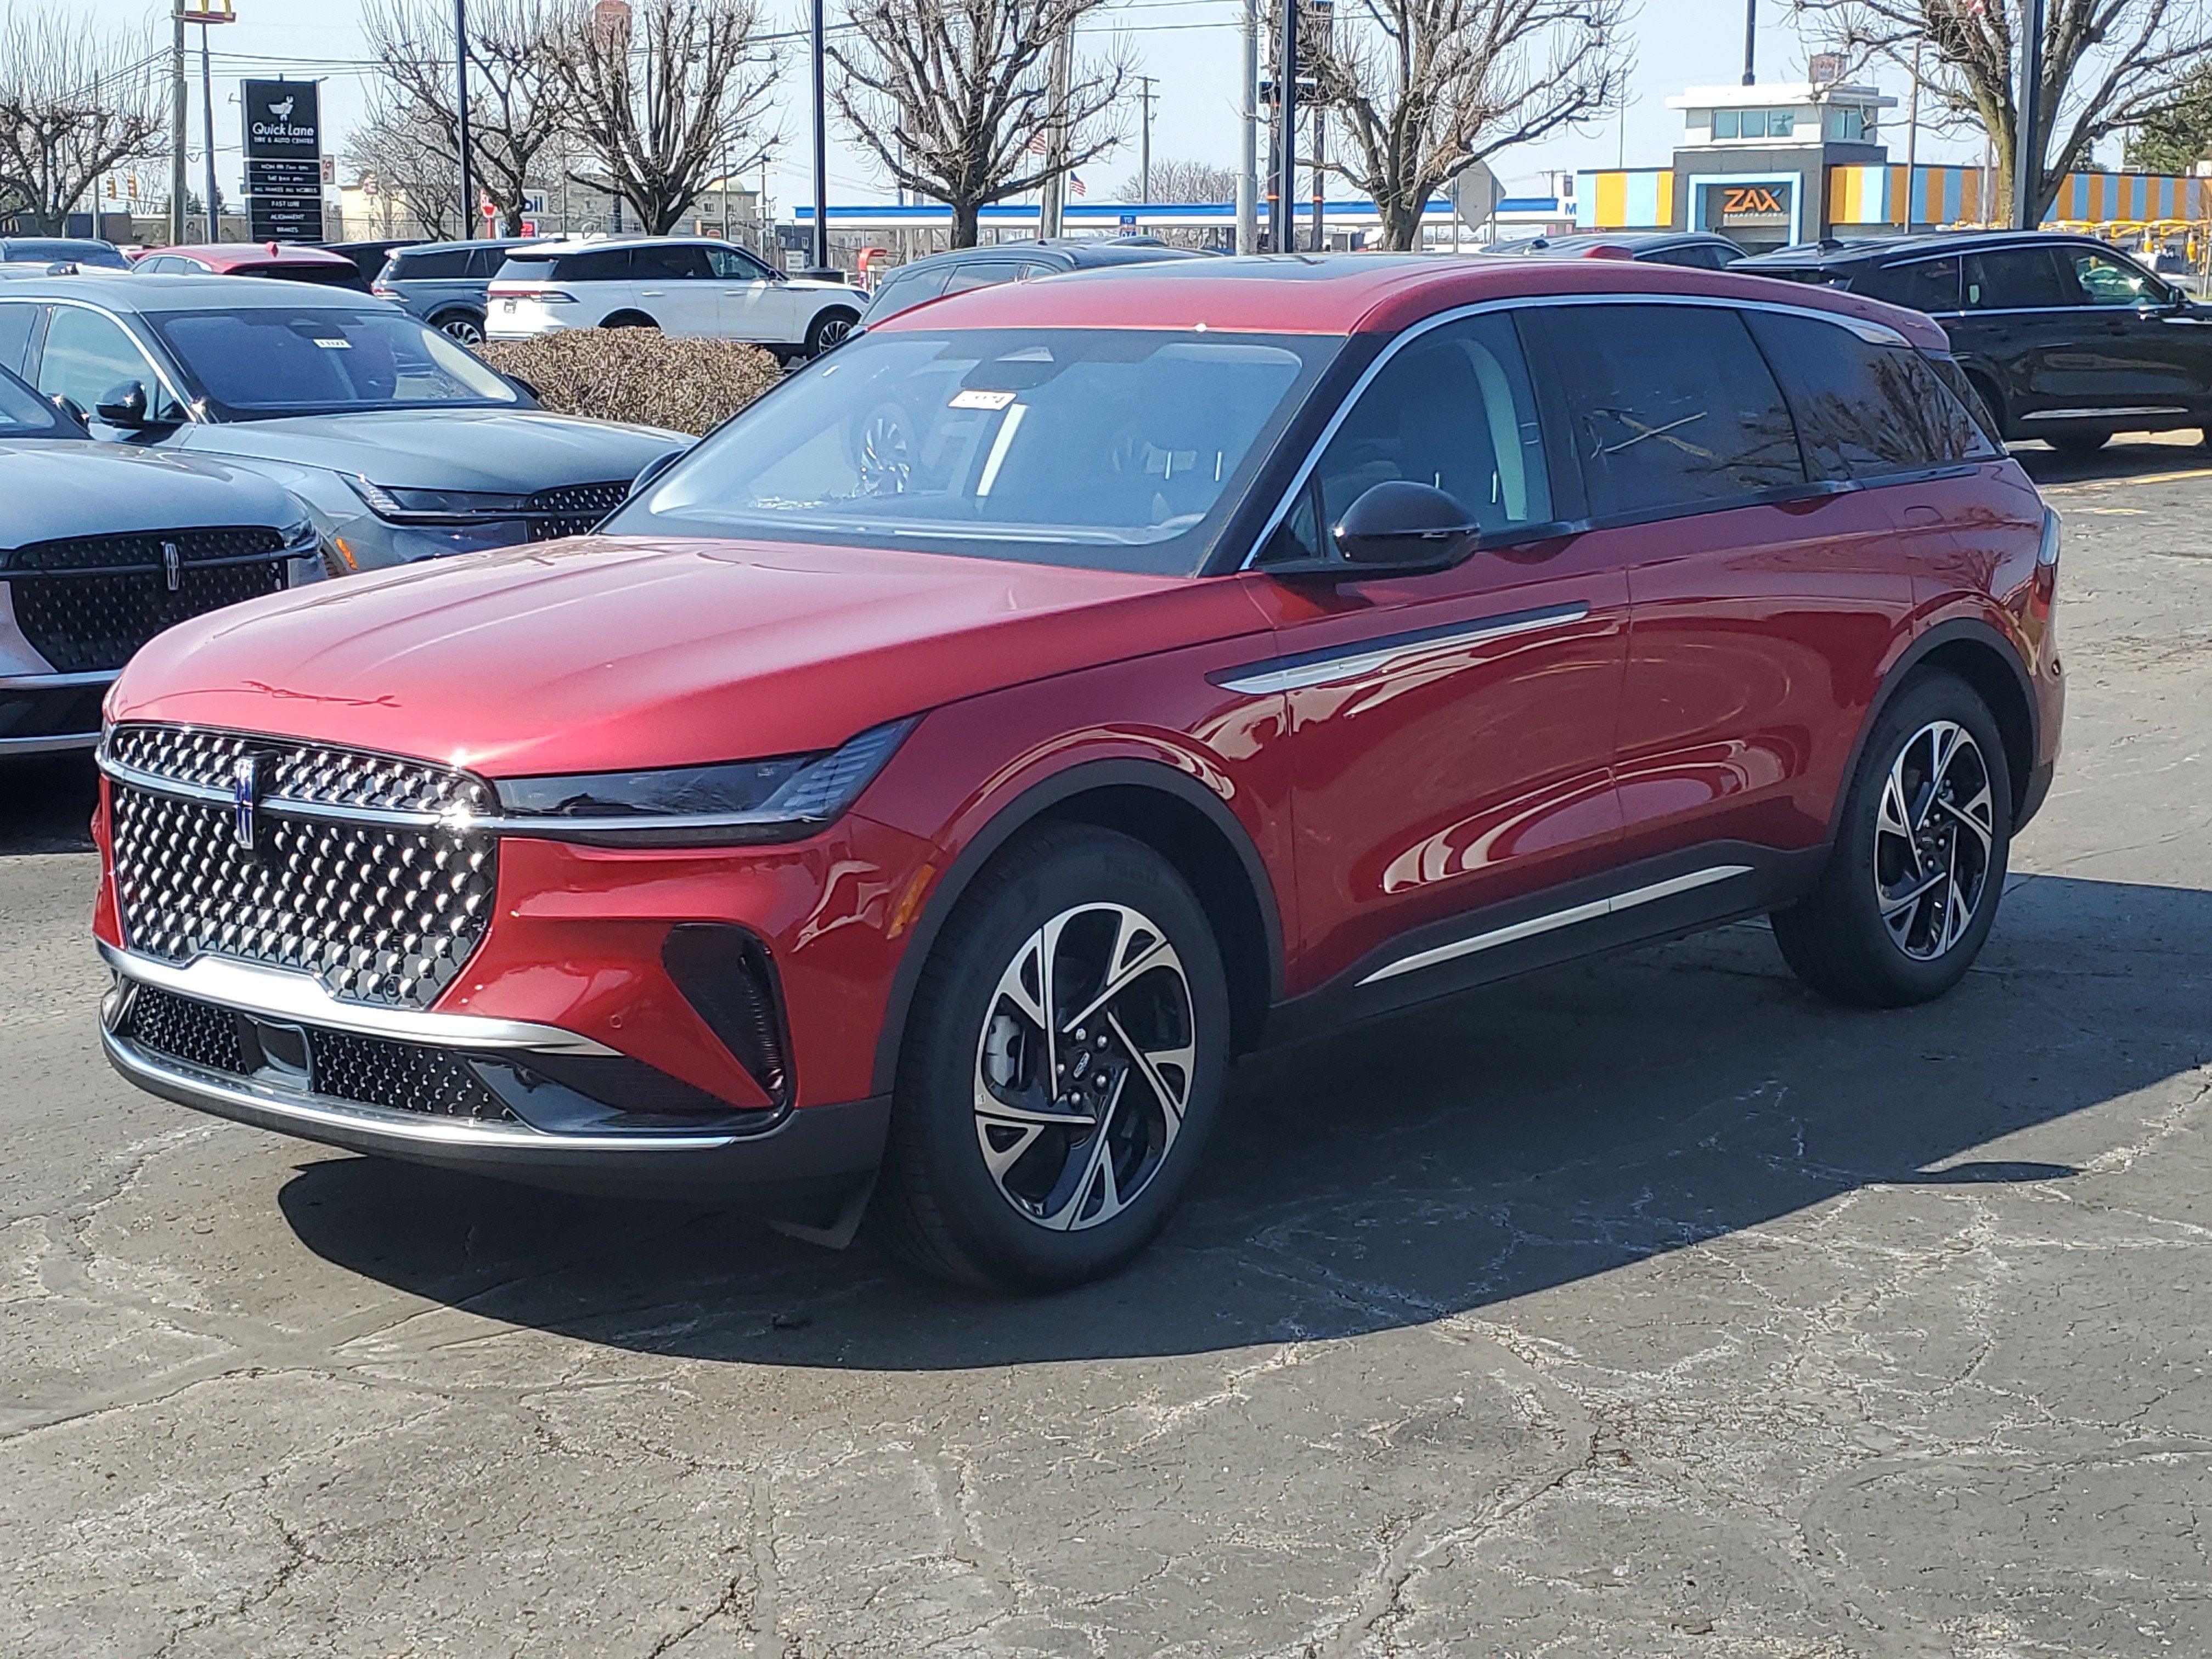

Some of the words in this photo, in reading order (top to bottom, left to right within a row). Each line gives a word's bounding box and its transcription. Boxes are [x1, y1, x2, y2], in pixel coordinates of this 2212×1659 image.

[252, 122, 286, 135] Quick
[287, 122, 314, 136] Lane
[1724, 188, 1782, 212] ZAX
